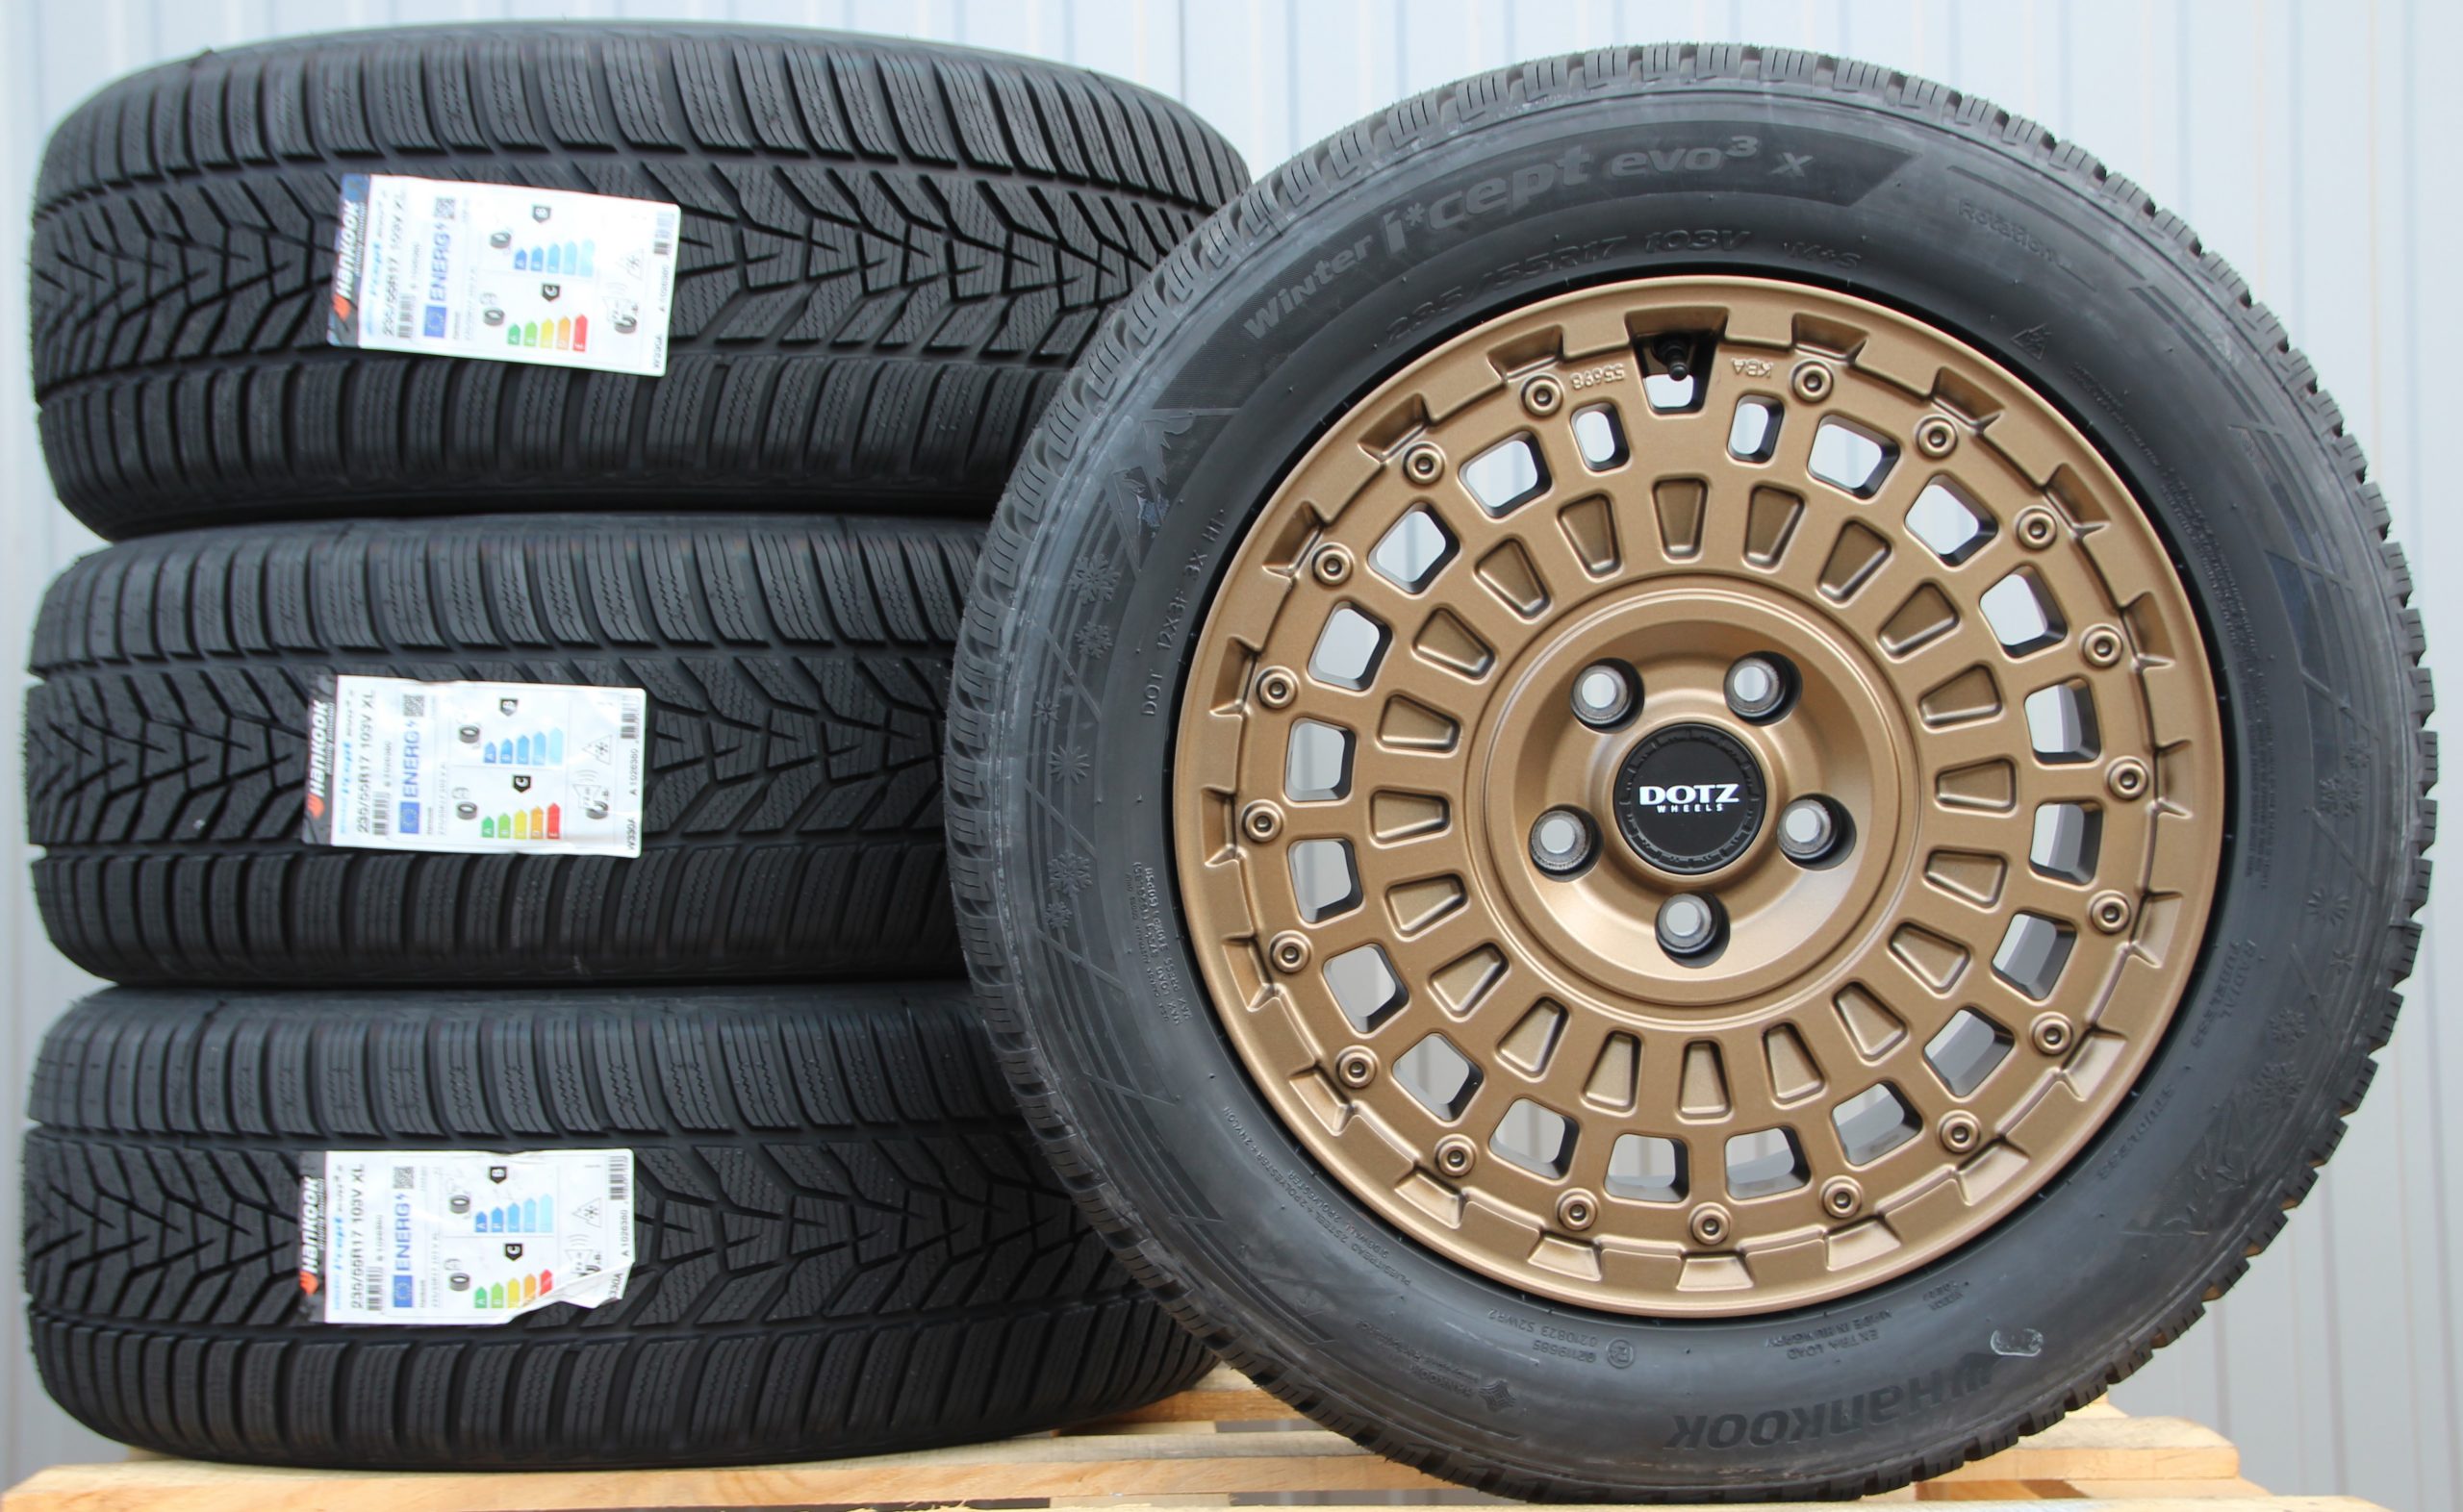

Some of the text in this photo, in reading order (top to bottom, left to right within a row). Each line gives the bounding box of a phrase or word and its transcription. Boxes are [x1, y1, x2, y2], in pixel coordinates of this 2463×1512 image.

[335, 199, 358, 299] Hankook
[428, 232, 450, 301] ENERG
[1953, 196, 2060, 264] Rotation
[1240, 230, 1378, 340] Winter
[1376, 236, 1629, 347] 235/55R17
[1642, 228, 1751, 252] 103V
[1139, 668, 1165, 717] DOT
[308, 699, 328, 796] Hankook
[356, 691, 373, 833] 235/55R17 103V XL
[401, 730, 419, 797] ENERG
[1639, 784, 1739, 805] DOTZ
[1657, 804, 1723, 813] WHEELS
[303, 1177, 317, 1273] Hankook
[350, 1165, 362, 1309] 235/55R17 103V XL
[394, 1202, 410, 1271] ENERG
